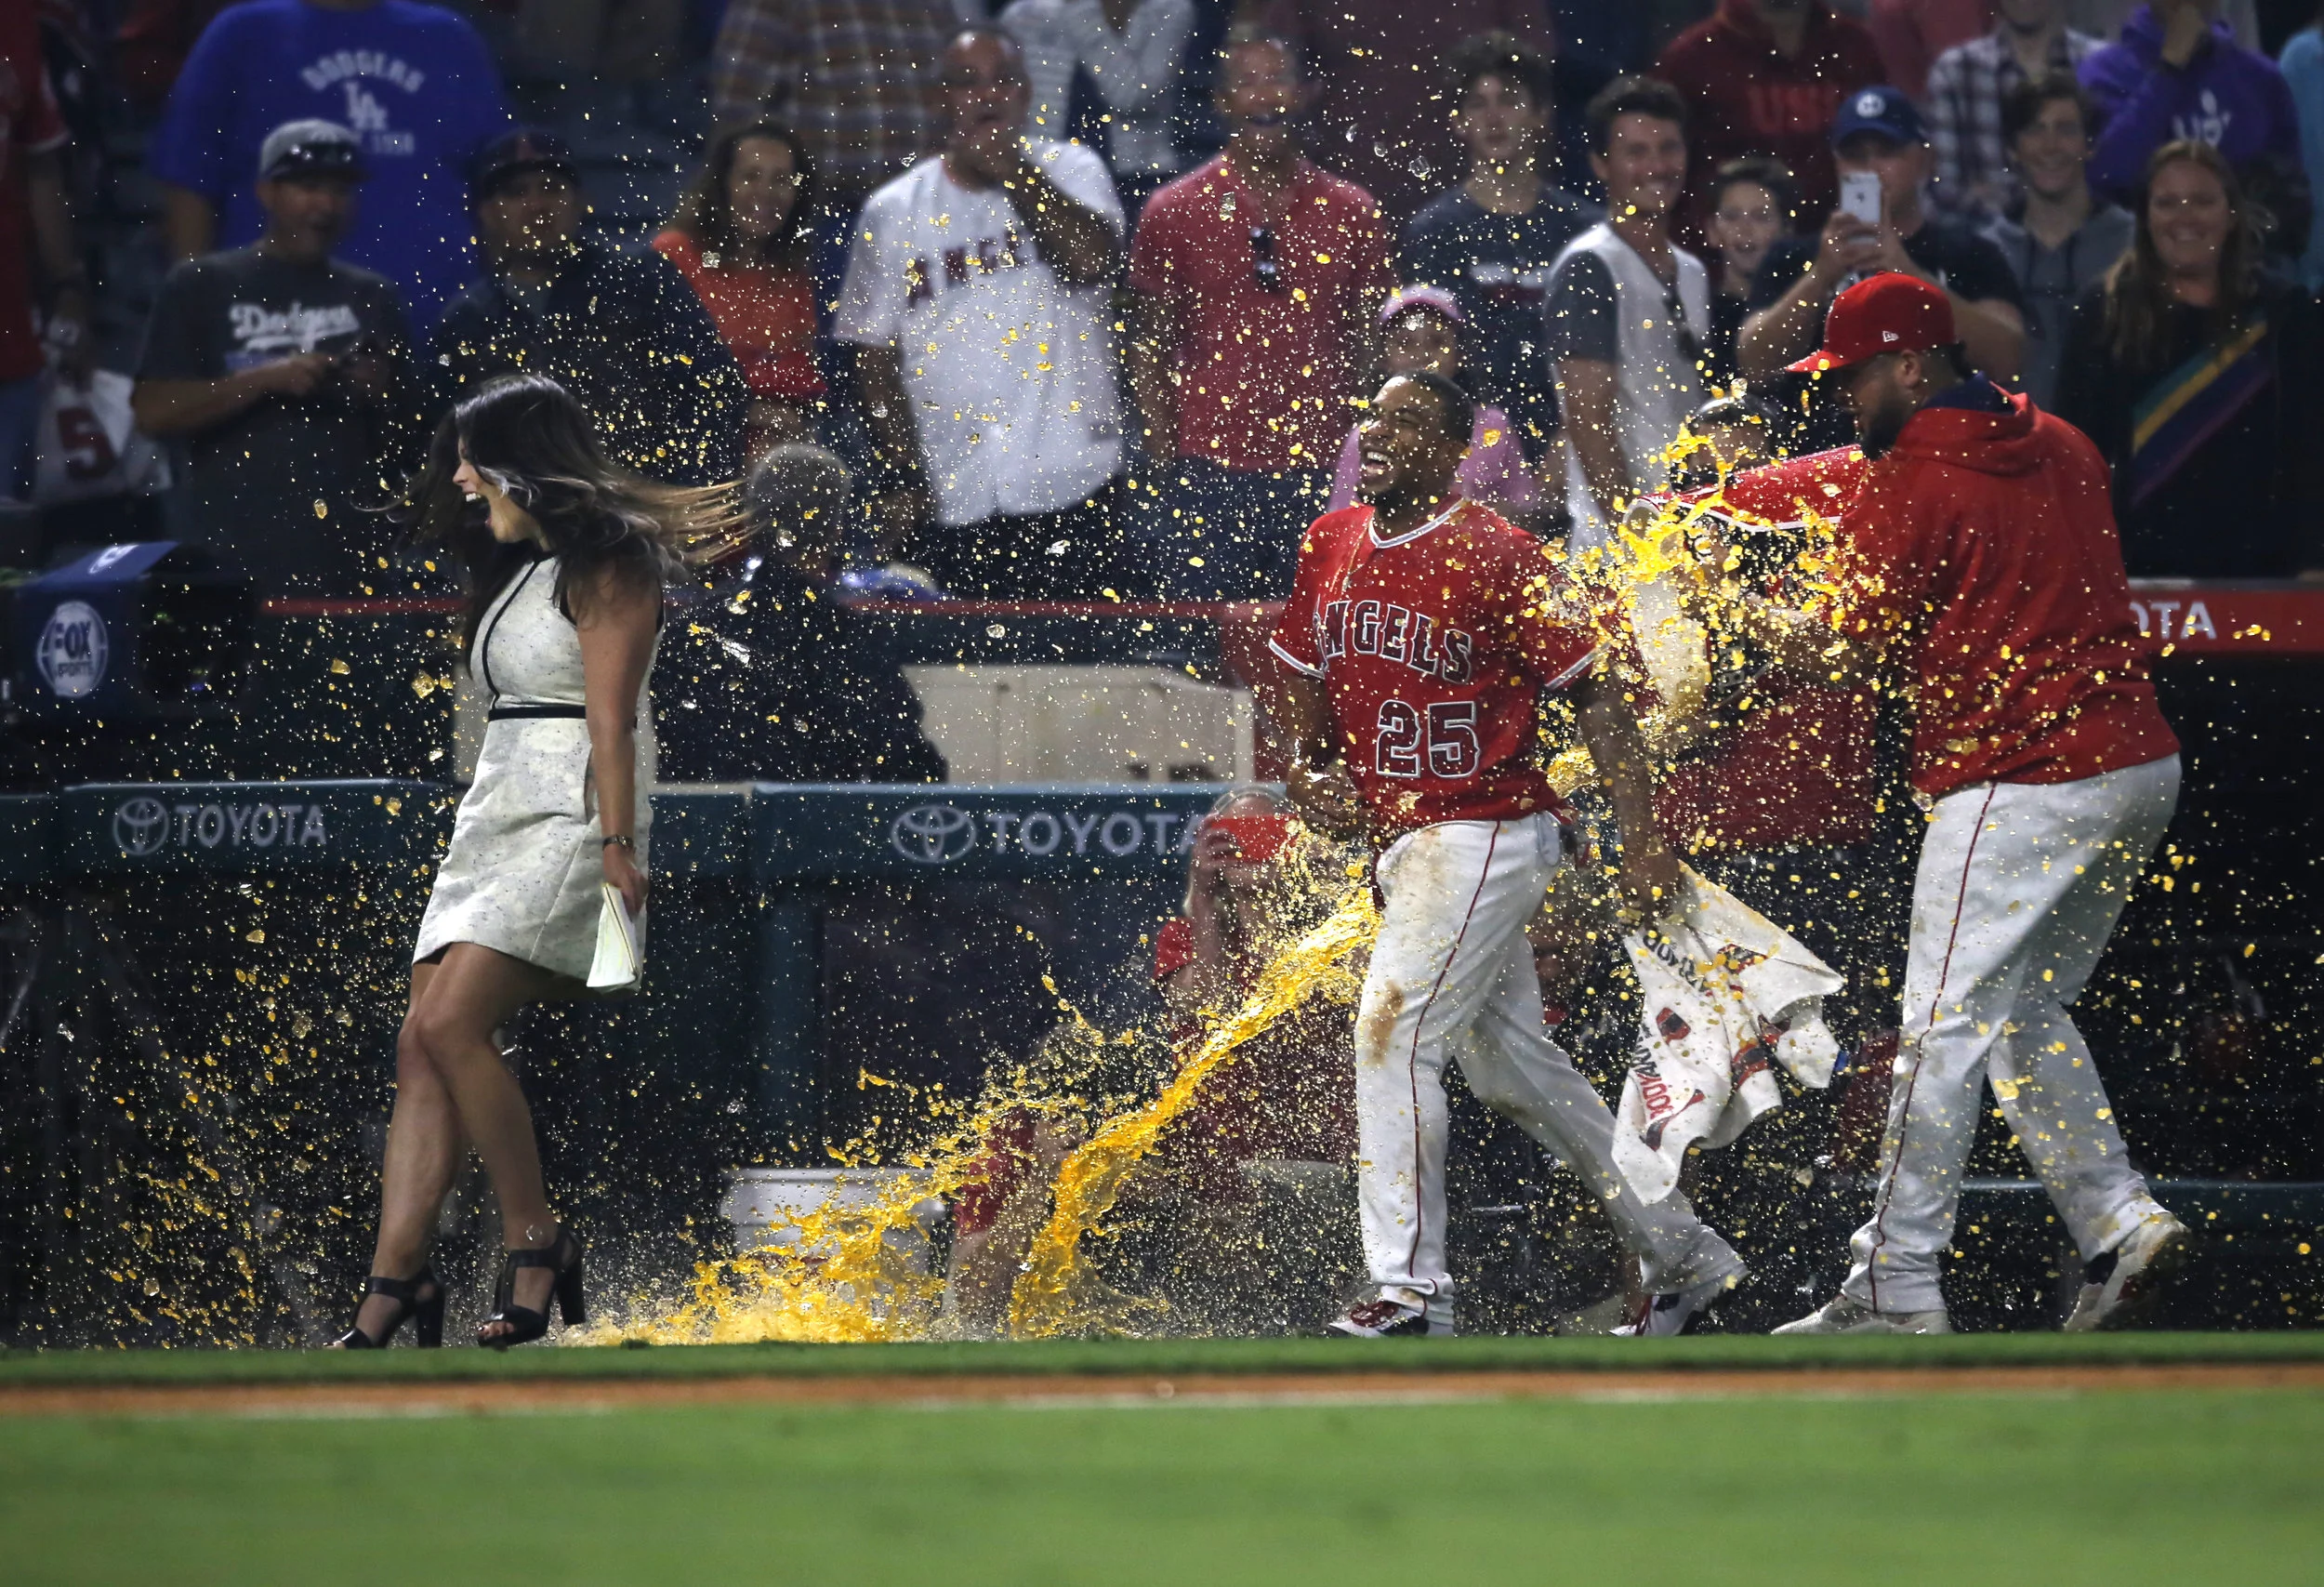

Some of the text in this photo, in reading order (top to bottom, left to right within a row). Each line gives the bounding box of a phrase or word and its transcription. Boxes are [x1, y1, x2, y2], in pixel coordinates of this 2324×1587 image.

[345, 82, 387, 130] LA
[230, 300, 360, 352] Dodgers
[55, 622, 91, 660] FOX
[1376, 699, 1481, 778] 25
[176, 804, 326, 847] TOYOTA
